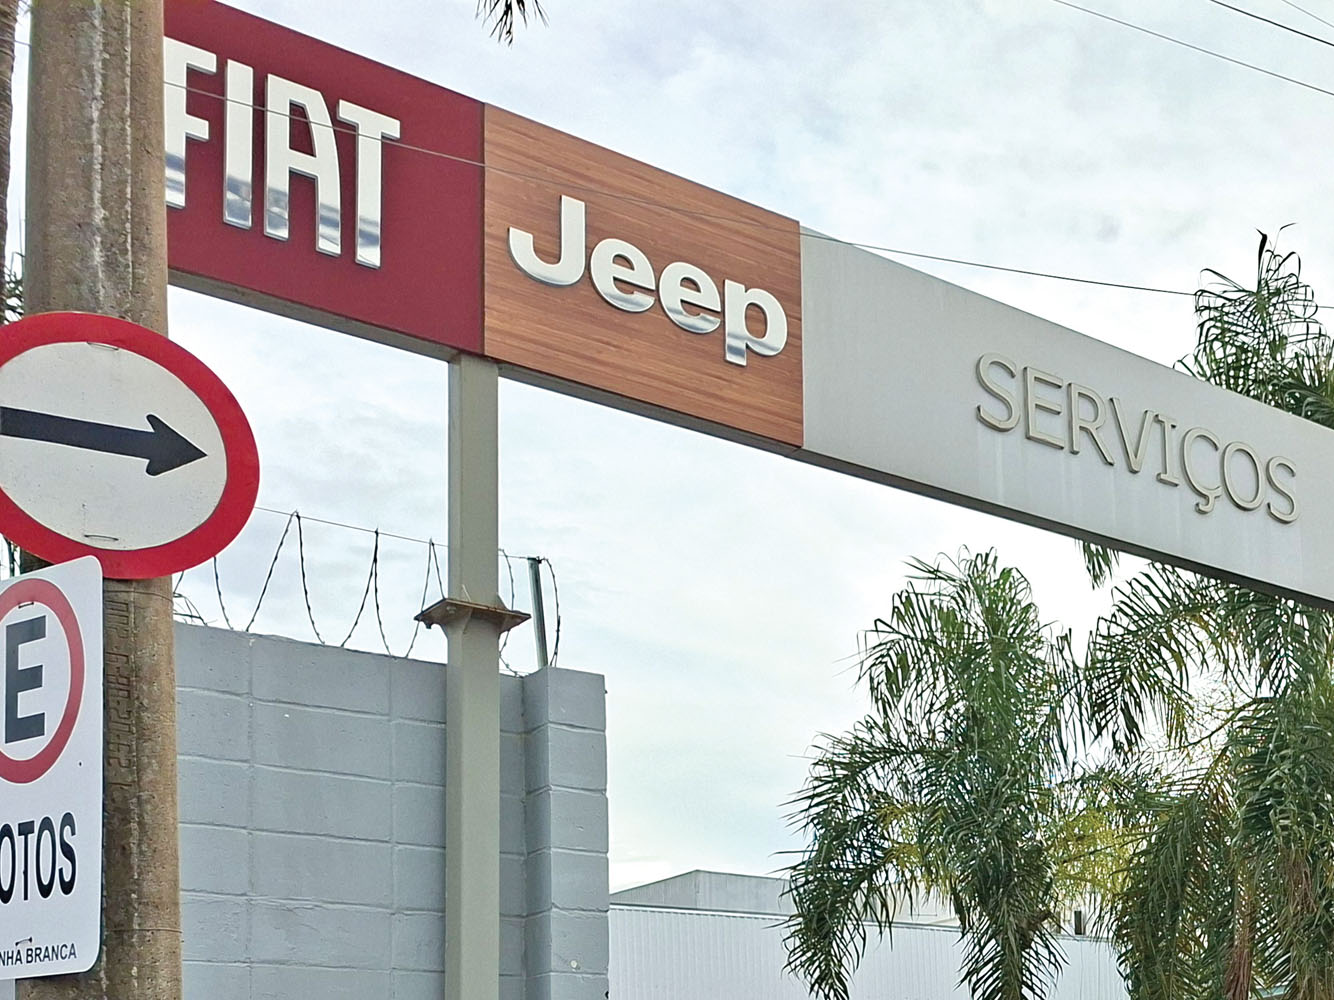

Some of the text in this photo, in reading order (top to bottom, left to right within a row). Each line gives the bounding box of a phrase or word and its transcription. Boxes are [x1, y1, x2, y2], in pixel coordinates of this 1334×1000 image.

[164, 36, 401, 270] FIAT
[507, 194, 789, 368] Jeep
[976, 352, 1299, 524] SERVIÇOS
[5, 615, 46, 744] E
[0, 811, 77, 904] OTOS
[26, 943, 77, 964] BRANCA
